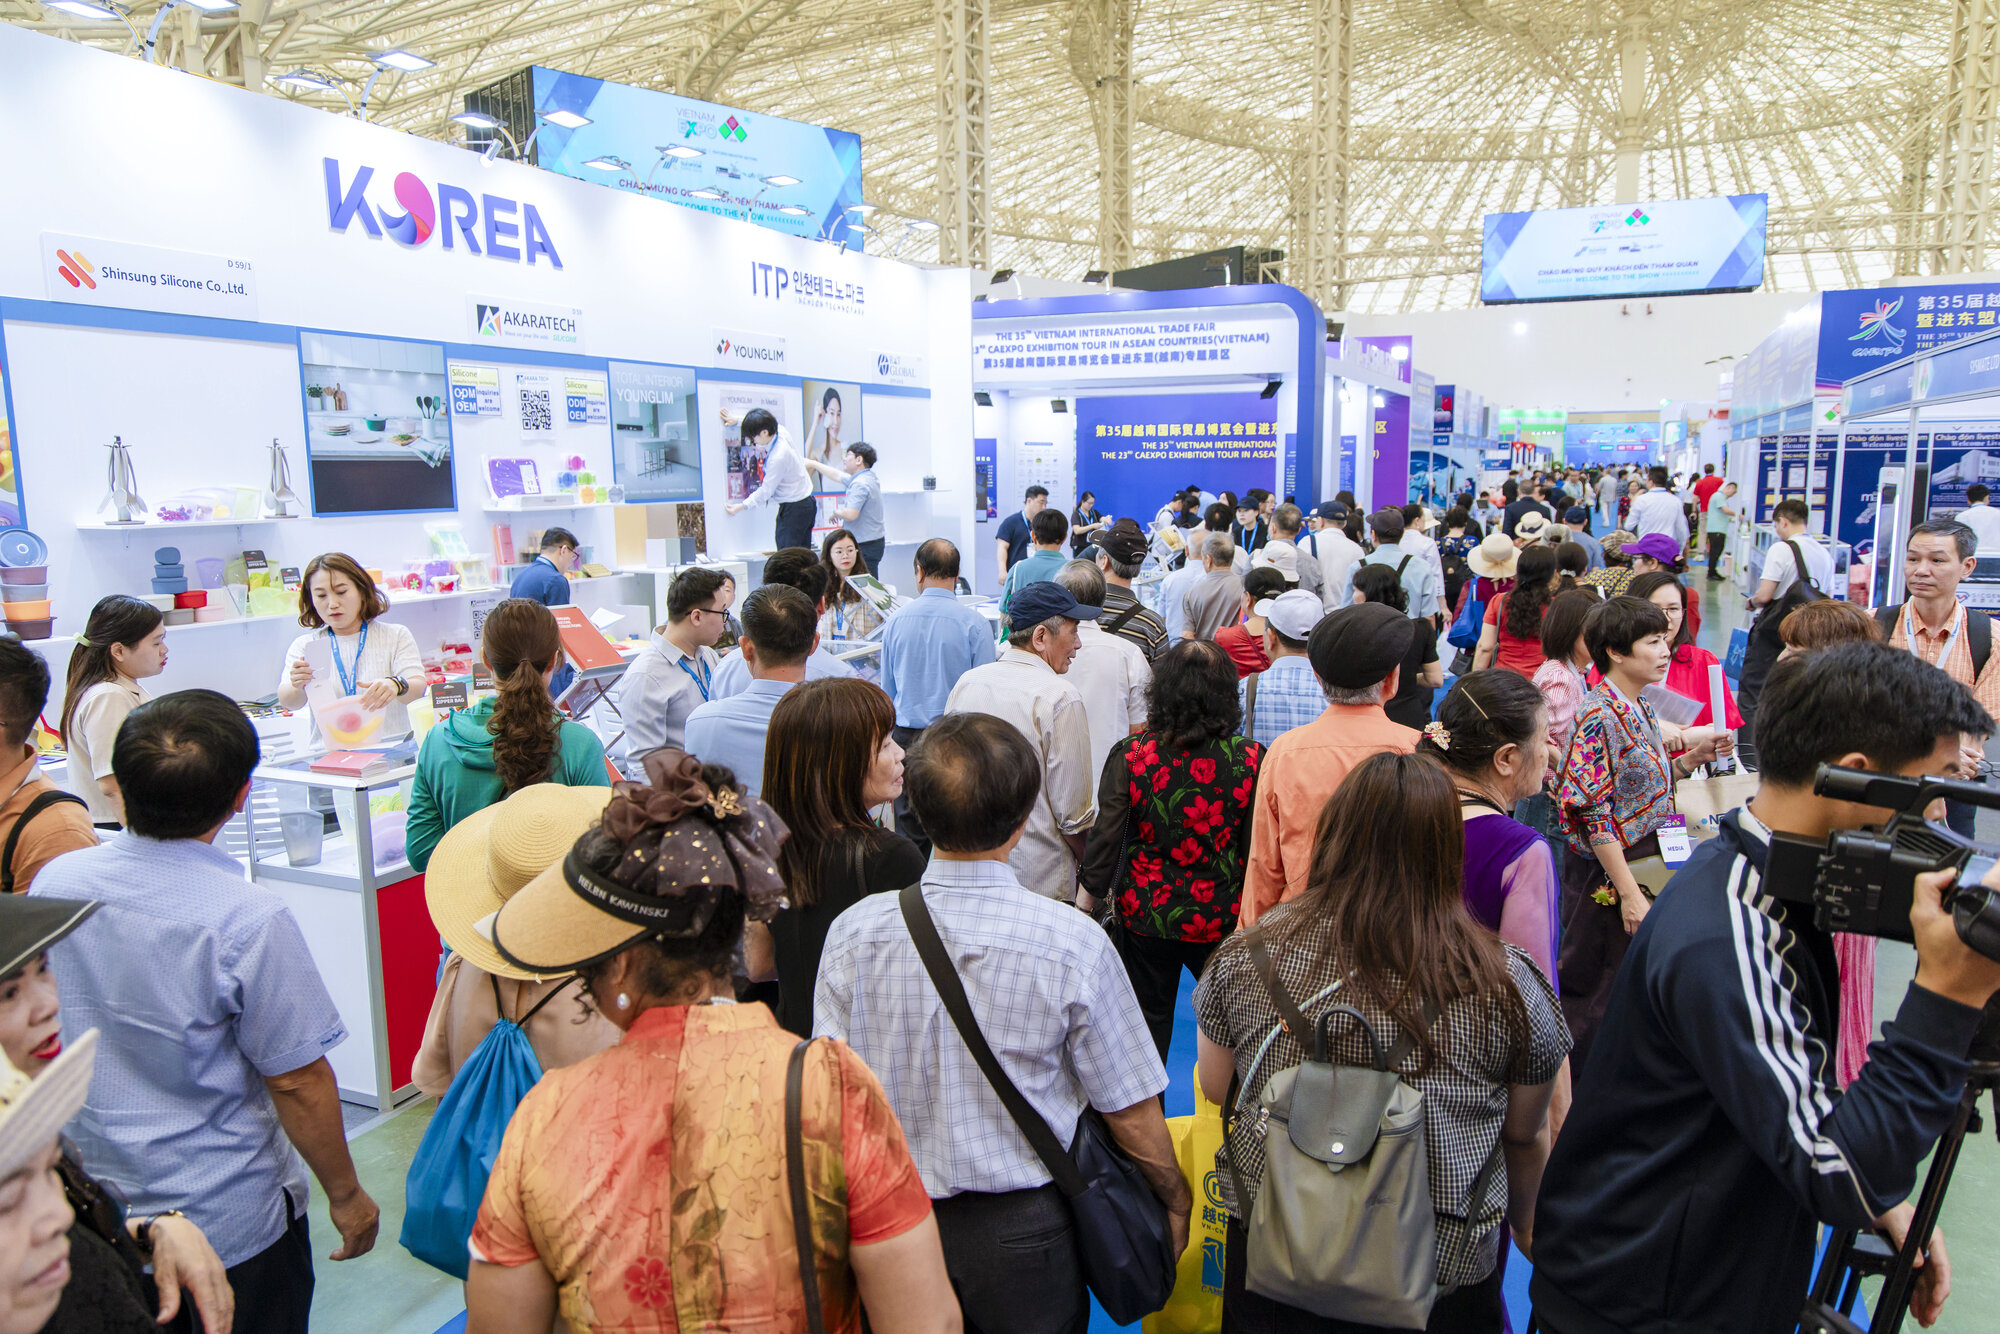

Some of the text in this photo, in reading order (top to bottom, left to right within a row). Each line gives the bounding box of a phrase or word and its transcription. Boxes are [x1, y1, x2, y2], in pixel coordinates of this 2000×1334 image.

[675, 107, 715, 122] VIETNAM
[678, 119, 718, 139] EXPO
[323, 157, 564, 270] KOREA
[711, 206, 721, 215] TO
[725, 208, 738, 217] THE
[235, 261, 251, 271] 59/1
[101, 266, 248, 296] Shinsung Silicone Co.,Ltd.
[752, 261, 789, 300] ITP
[1575, 274, 1609, 282] WELCOME
[793, 270, 865, 304] 인천테크노파크
[1917, 293, 2000, 311] 第35届越
[503, 311, 576, 333] AKARATECH
[995, 332, 1013, 341] THE
[1034, 329, 1076, 340] VIETNAM
[1079, 326, 1156, 338] INTERNATIONAL
[1158, 323, 1190, 334] TRADE
[1193, 322, 1216, 332] FAIR
[987, 344, 1024, 354] CAEXPO
[1026, 342, 1079, 353] EXHIBITION
[1081, 341, 1107, 350] TOUR
[1109, 340, 1120, 349] IN
[1122, 338, 1155, 348] ASEAN
[1158, 332, 1270, 346] COUNTRIES(VIETNAM)
[733, 344, 784, 362] YOUNGLIM
[452, 368, 478, 378] Silicone
[616, 372, 684, 388] TOTAL INTERIOR
[454, 387, 476, 399] ODM
[566, 381, 588, 389] Silicone
[568, 398, 586, 408] ODM
[616, 388, 674, 405] YOUNGLIM
[455, 401, 477, 412] OEM
[569, 410, 586, 420] OEM
[1142, 441, 1157, 449] THE
[1176, 441, 1213, 449] VIETNAM
[1101, 451, 1116, 459] THE
[1135, 451, 1167, 459] CAEXPO
[1168, 451, 1215, 459] EXHIBITION
[1217, 450, 1240, 459] TOUR
[1241, 450, 1251, 458] IN
[1252, 450, 1277, 458] ASEA
[1202, 1204, 1229, 1229] 越中
